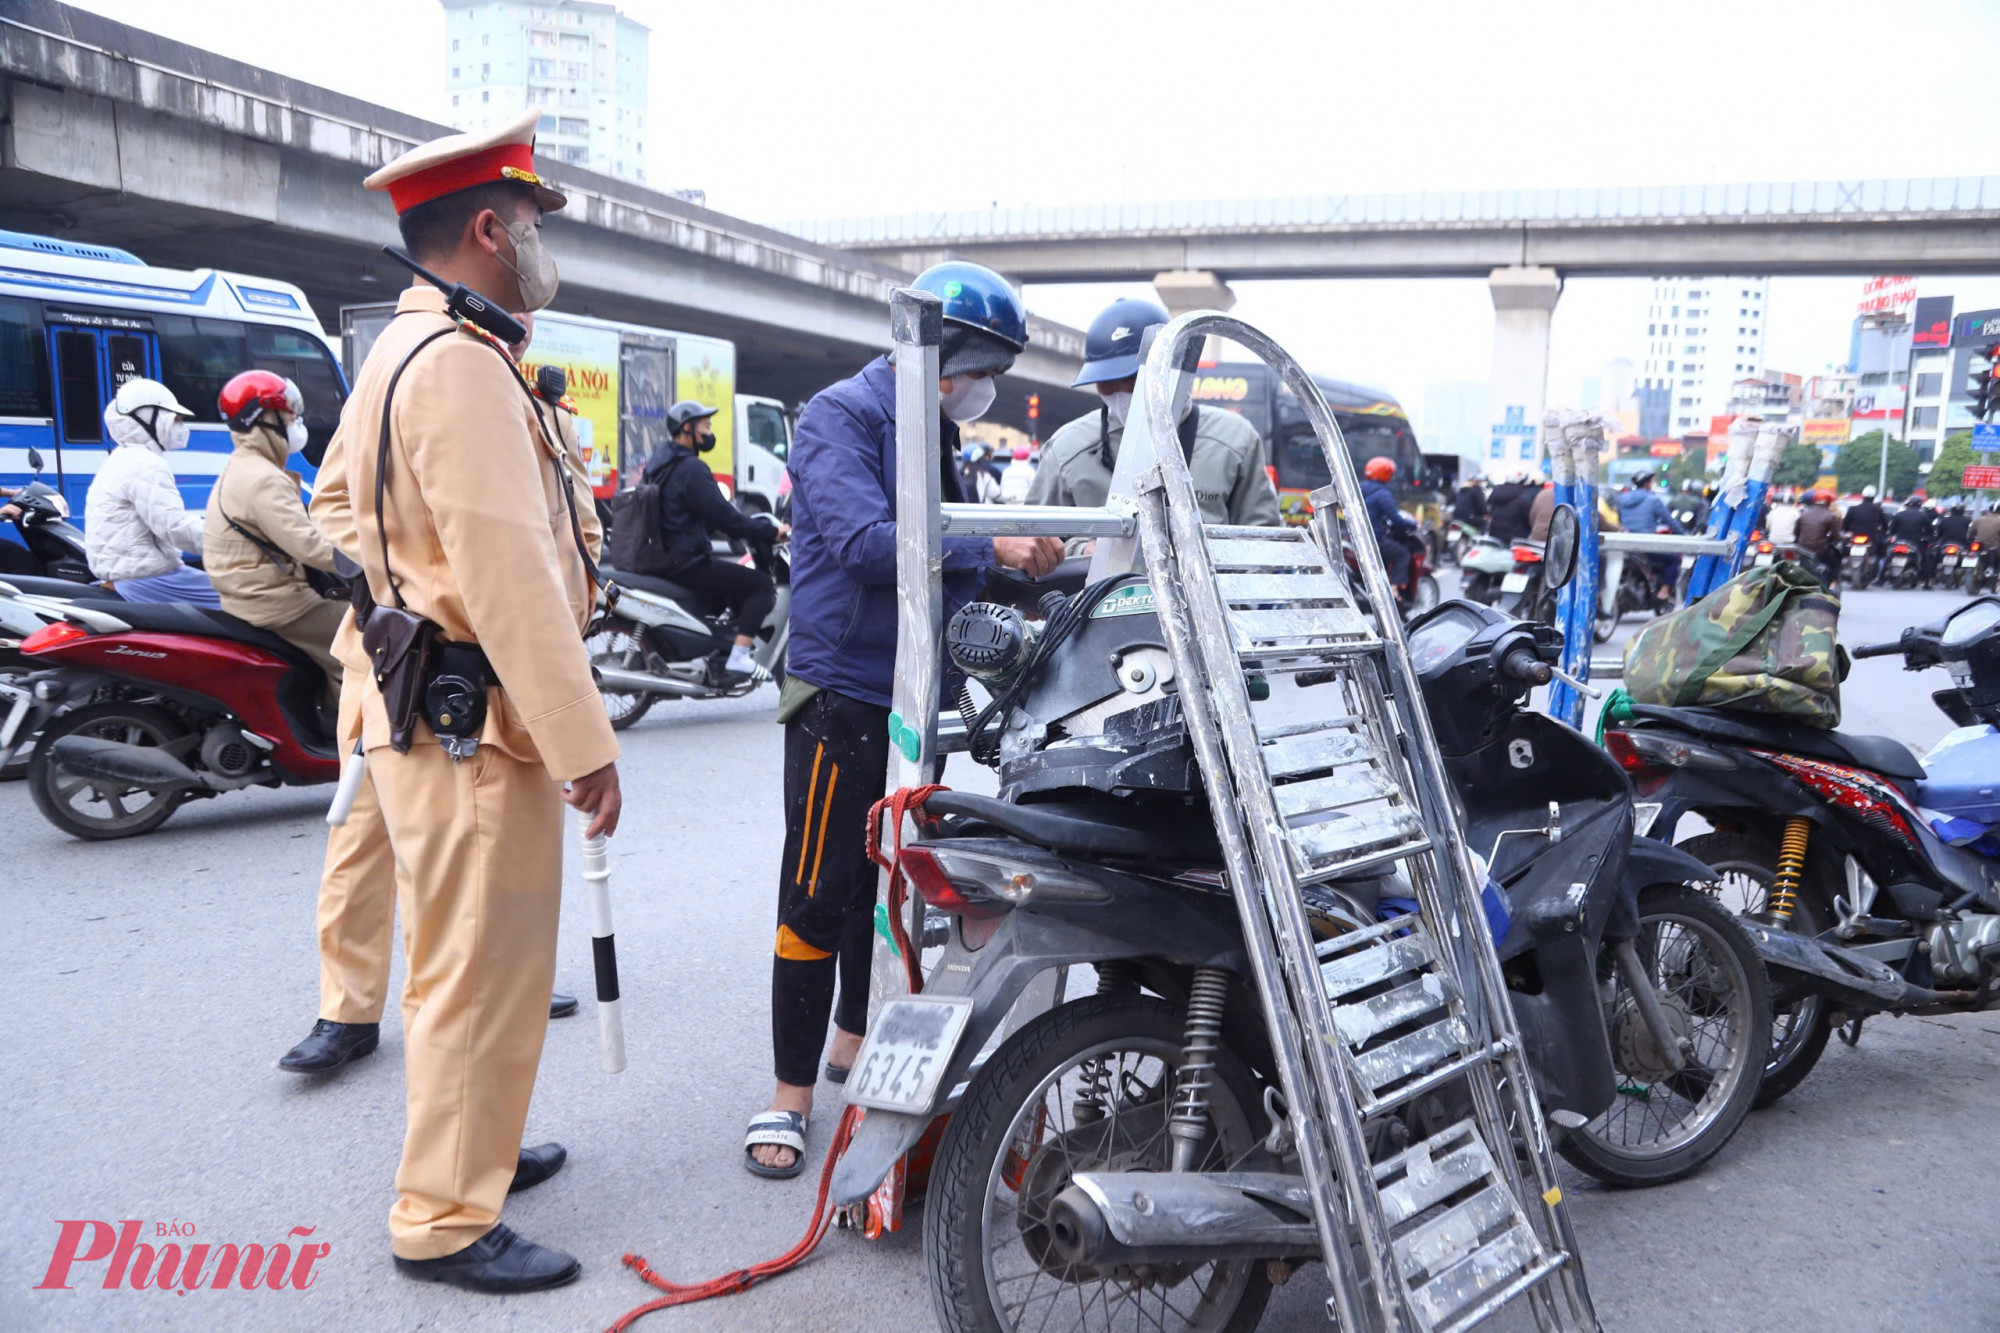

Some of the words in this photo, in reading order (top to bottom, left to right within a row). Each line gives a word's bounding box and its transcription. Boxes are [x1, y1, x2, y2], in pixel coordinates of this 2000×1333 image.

[581, 367, 609, 394] NỘI
[1195, 490, 1220, 501] Dior
[1117, 594, 1155, 607] DEKTO
[104, 645, 168, 659] Janus
[946, 964, 971, 973] HONDA
[856, 1052, 933, 1103] 6345
[757, 1133, 789, 1141] LACOSTE
